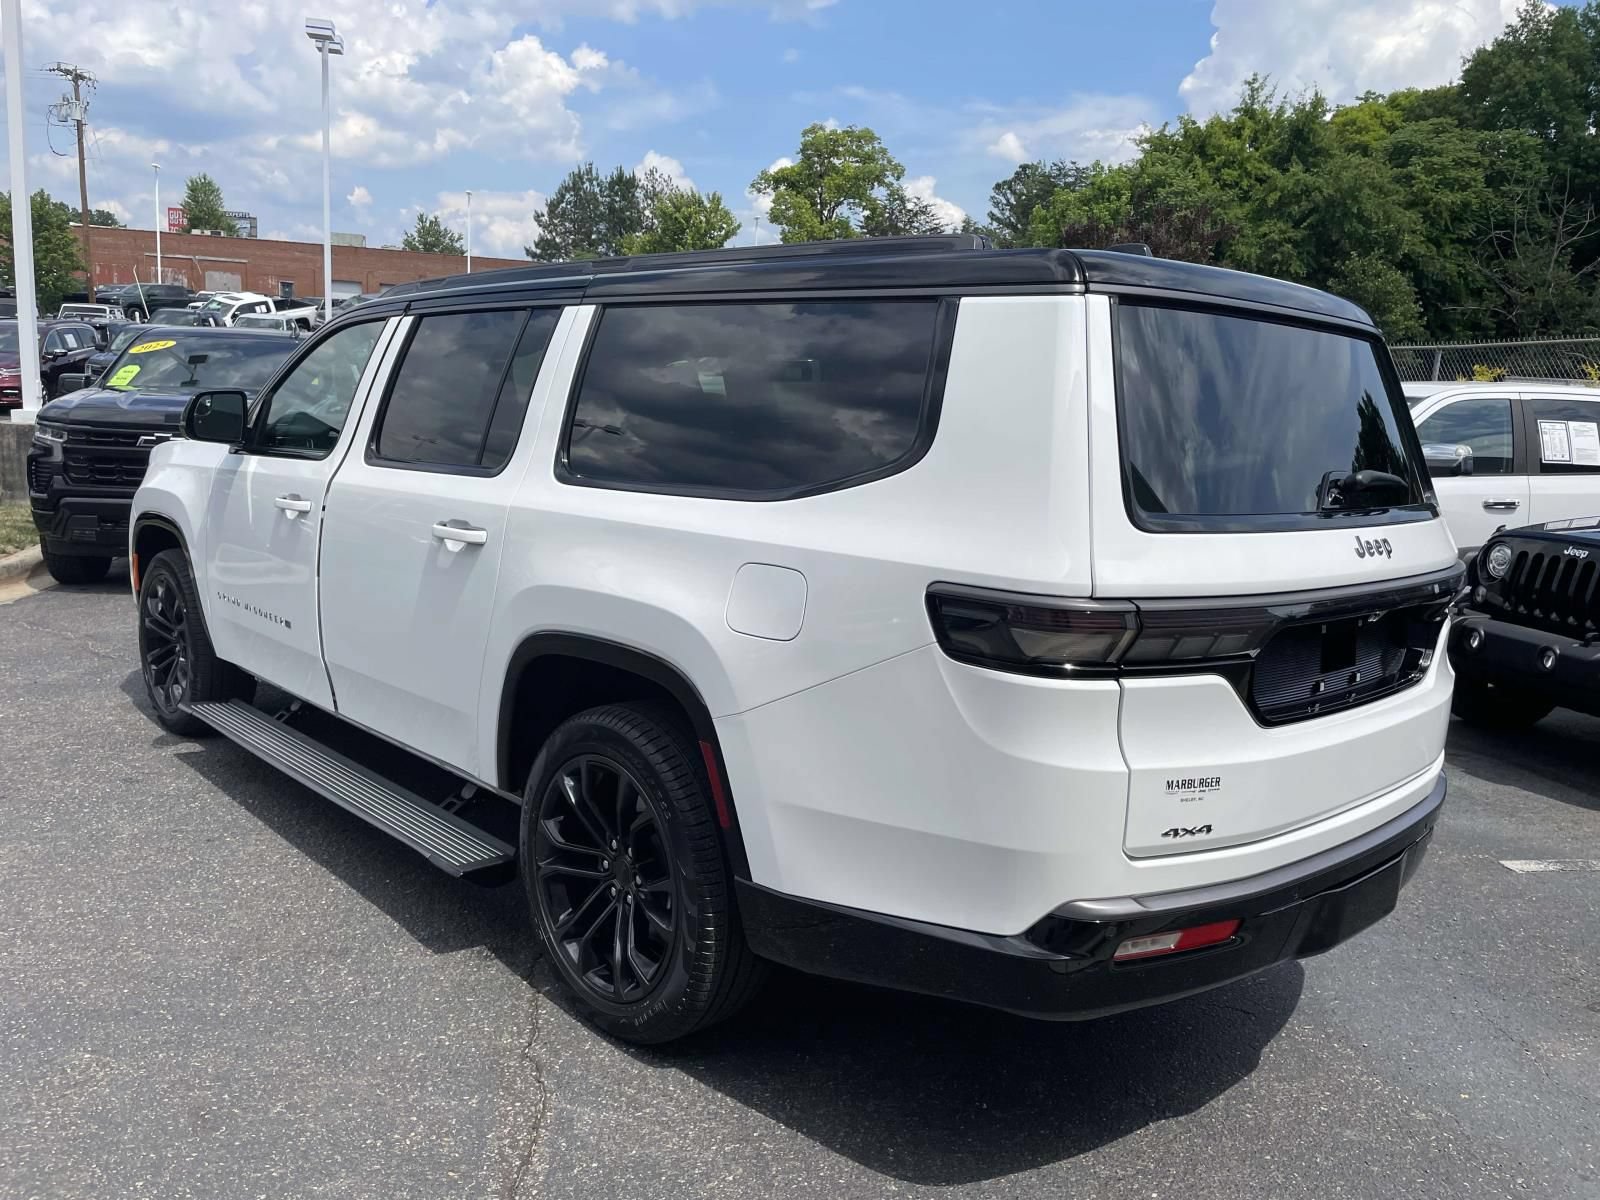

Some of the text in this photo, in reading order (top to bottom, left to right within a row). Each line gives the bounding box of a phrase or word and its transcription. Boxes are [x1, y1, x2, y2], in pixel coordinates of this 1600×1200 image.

[1354, 535, 1392, 560] Jeep
[1563, 545, 1589, 559] Jeep
[1166, 776, 1220, 790] MARBURGER
